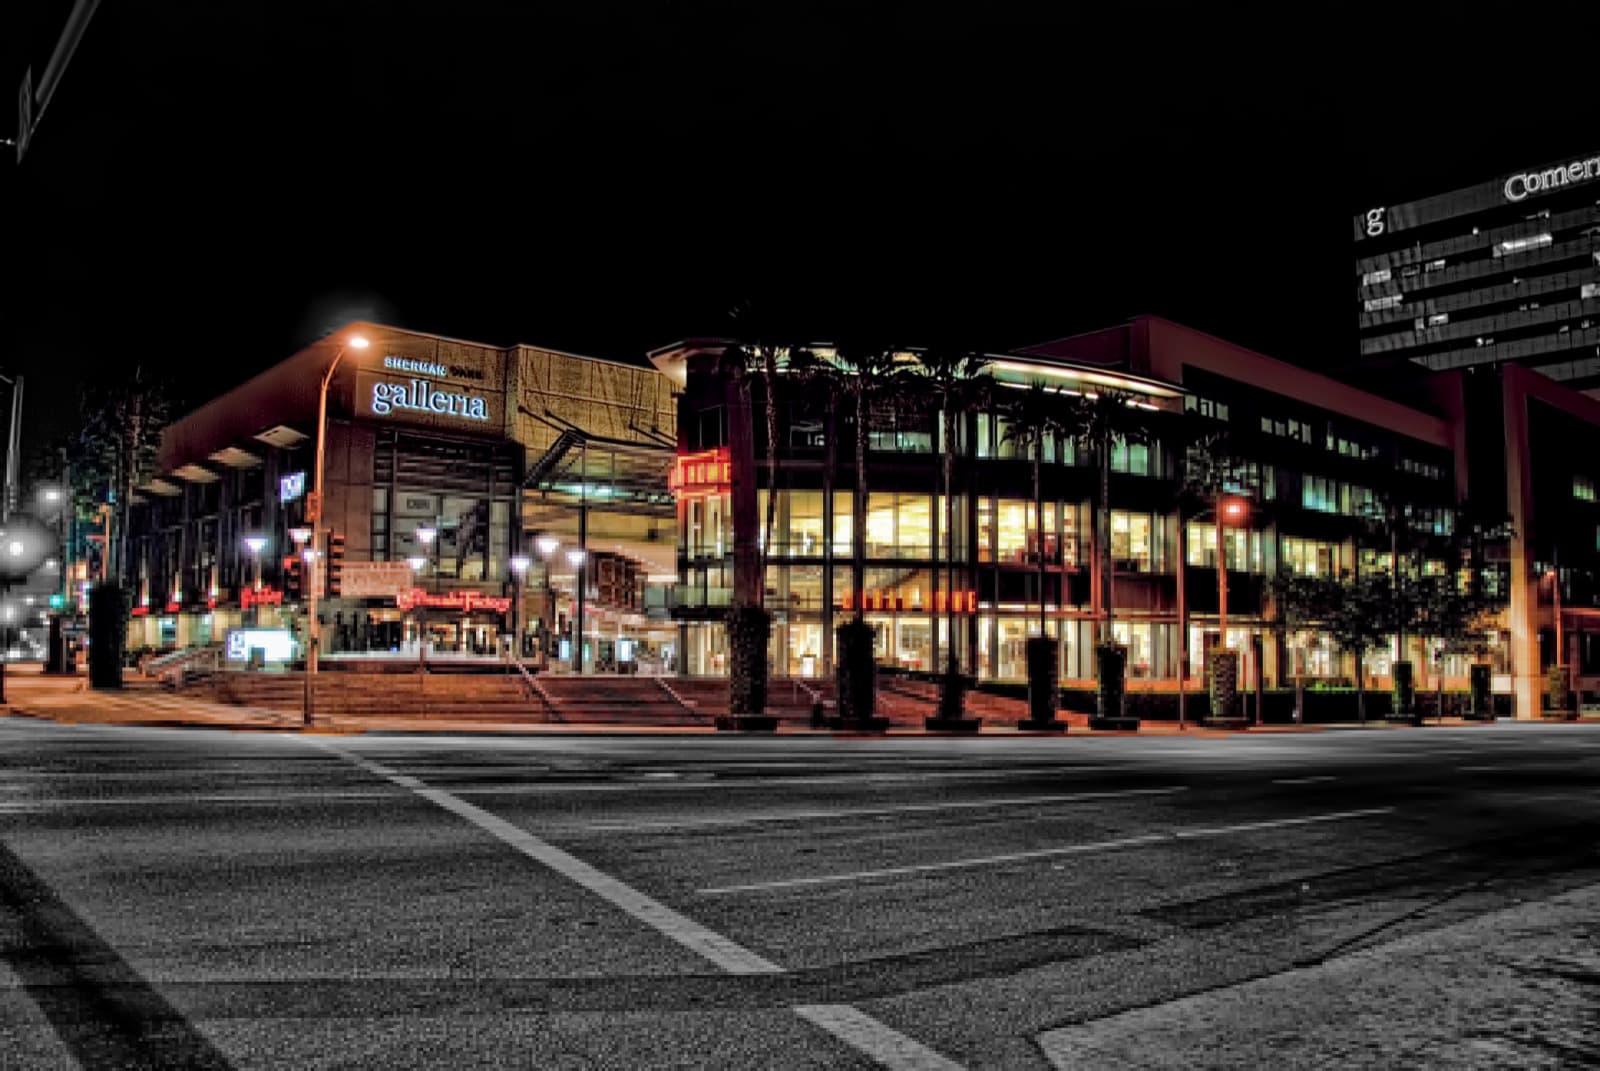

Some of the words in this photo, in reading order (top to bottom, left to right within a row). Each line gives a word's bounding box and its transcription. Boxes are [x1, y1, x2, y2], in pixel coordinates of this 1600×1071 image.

[1366, 206, 1385, 236] g
[384, 356, 447, 377] SHERMAN
[372, 378, 489, 420] galleria
